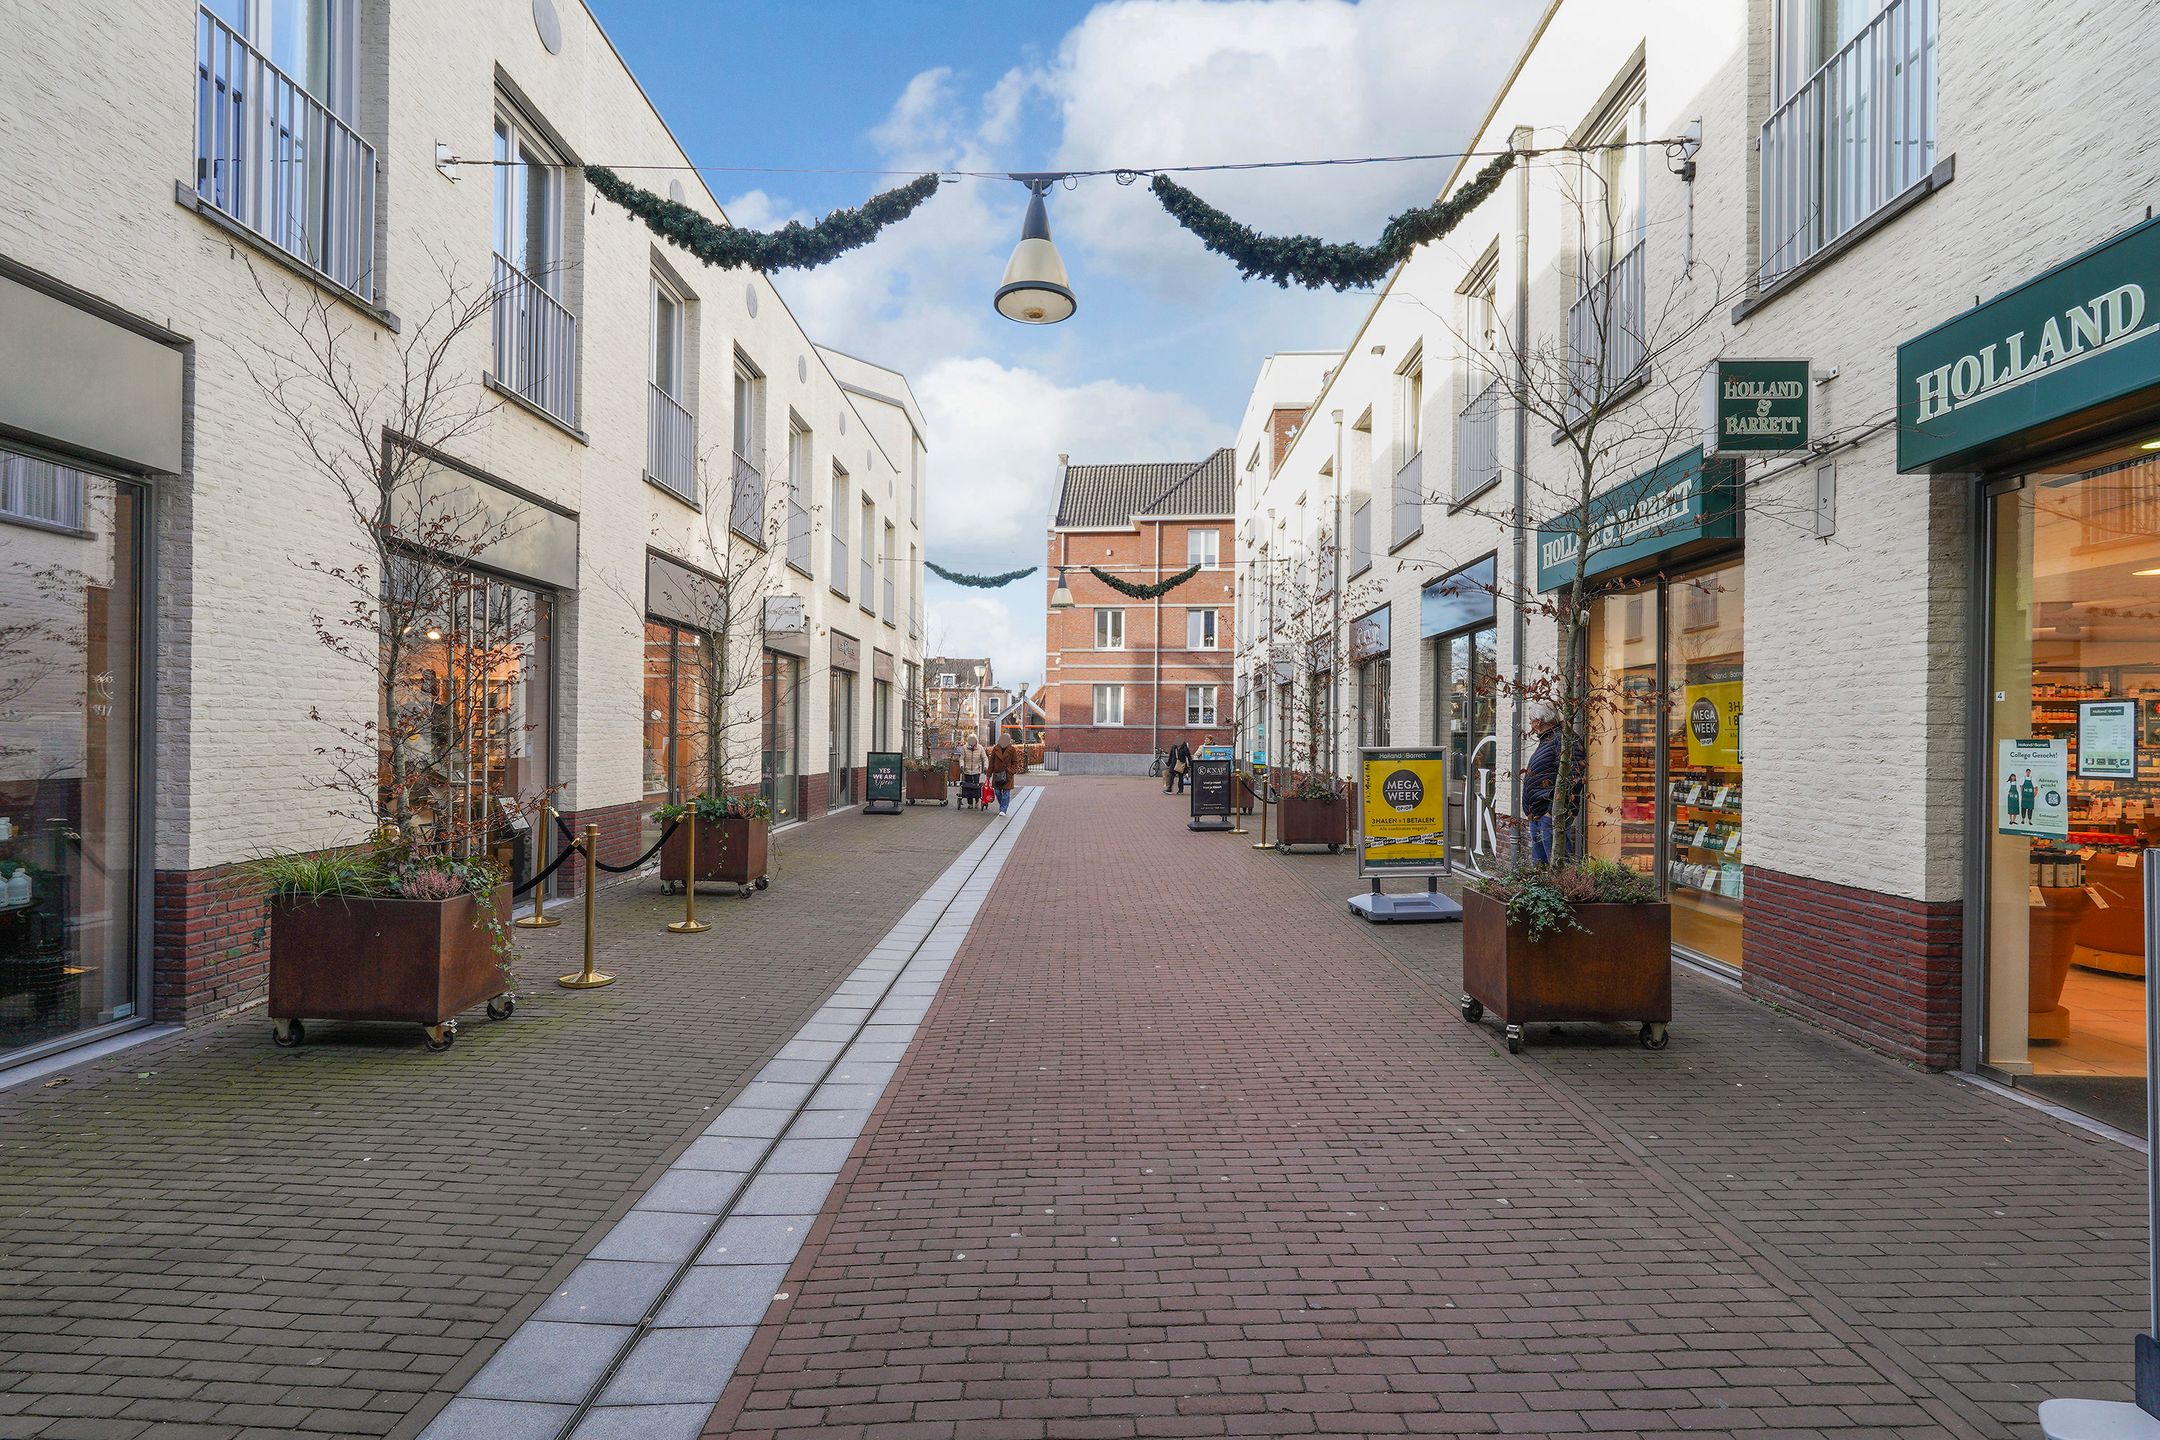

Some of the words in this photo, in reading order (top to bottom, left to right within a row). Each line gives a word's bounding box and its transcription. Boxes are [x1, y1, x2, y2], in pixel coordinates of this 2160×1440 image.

[1916, 283, 2146, 425] HOLLAND
[1723, 381, 1804, 399] HOLLAND
[1757, 399, 1773, 417] &
[1725, 416, 1801, 434] BARRETT
[1693, 709, 1716, 720] MEGA
[1694, 722, 1716, 733] WEEK
[1387, 780, 1420, 790] MEGA
[1387, 791, 1419, 801] WEEK
